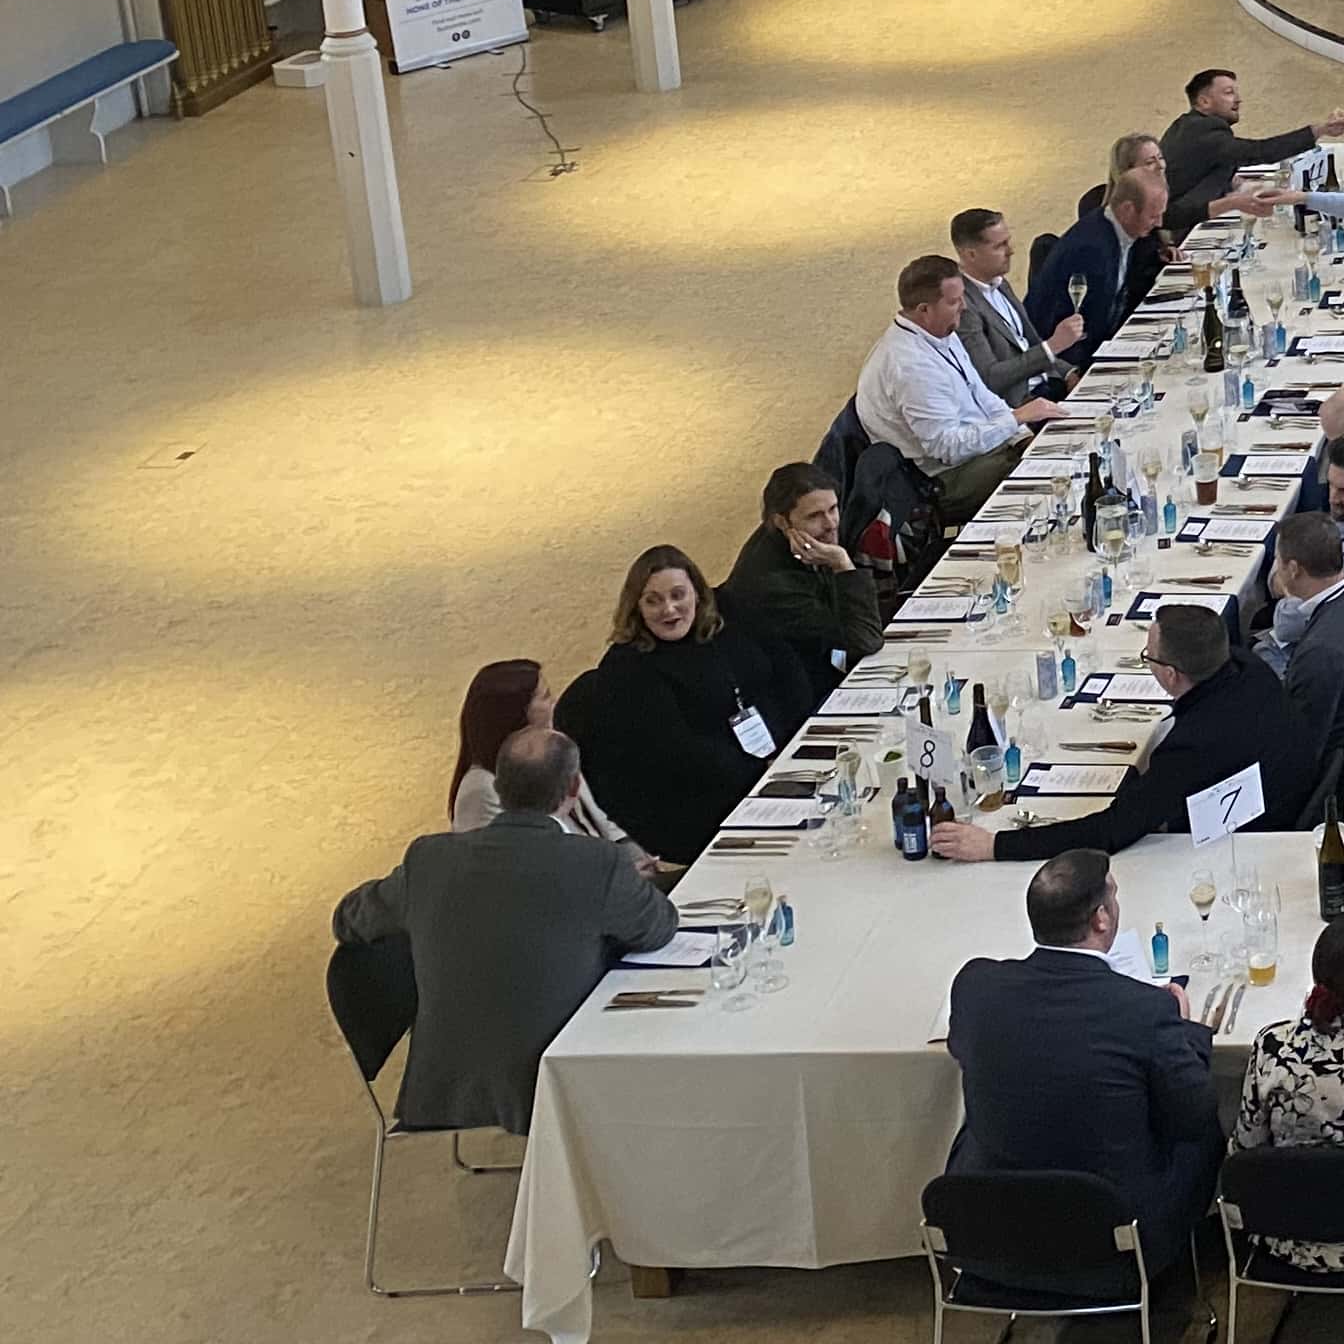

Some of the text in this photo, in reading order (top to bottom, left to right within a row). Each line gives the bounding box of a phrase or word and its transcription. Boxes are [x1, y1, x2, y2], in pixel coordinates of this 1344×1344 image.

[406, 1, 430, 15] NONE
[920, 739, 936, 768] 8
[1220, 785, 1242, 824] 7
